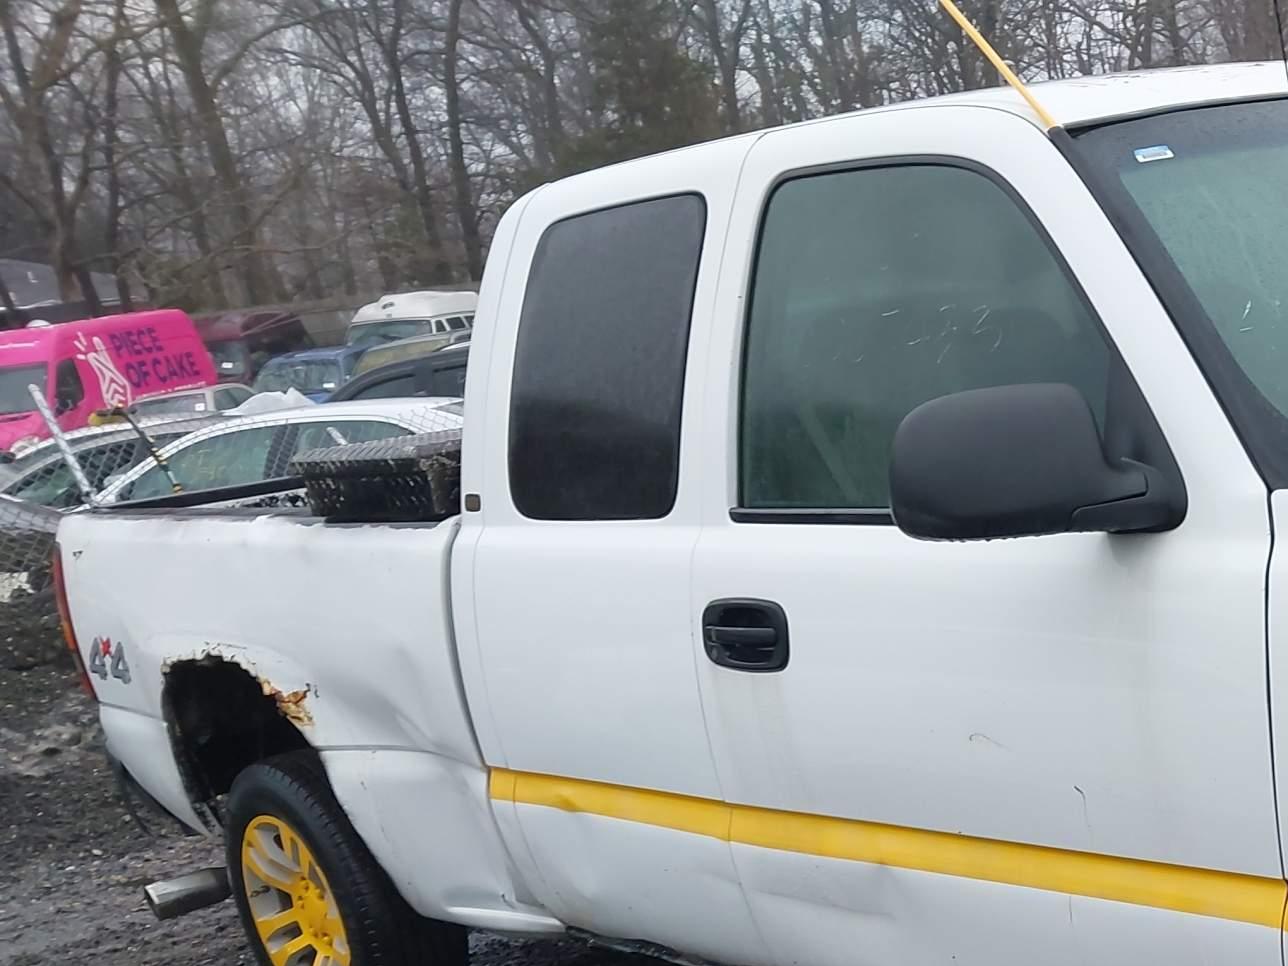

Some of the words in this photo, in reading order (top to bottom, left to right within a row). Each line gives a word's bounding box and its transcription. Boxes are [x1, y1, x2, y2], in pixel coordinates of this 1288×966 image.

[109, 327, 164, 357] PIECE
[125, 360, 150, 388] OF
[152, 352, 200, 383] CAKE
